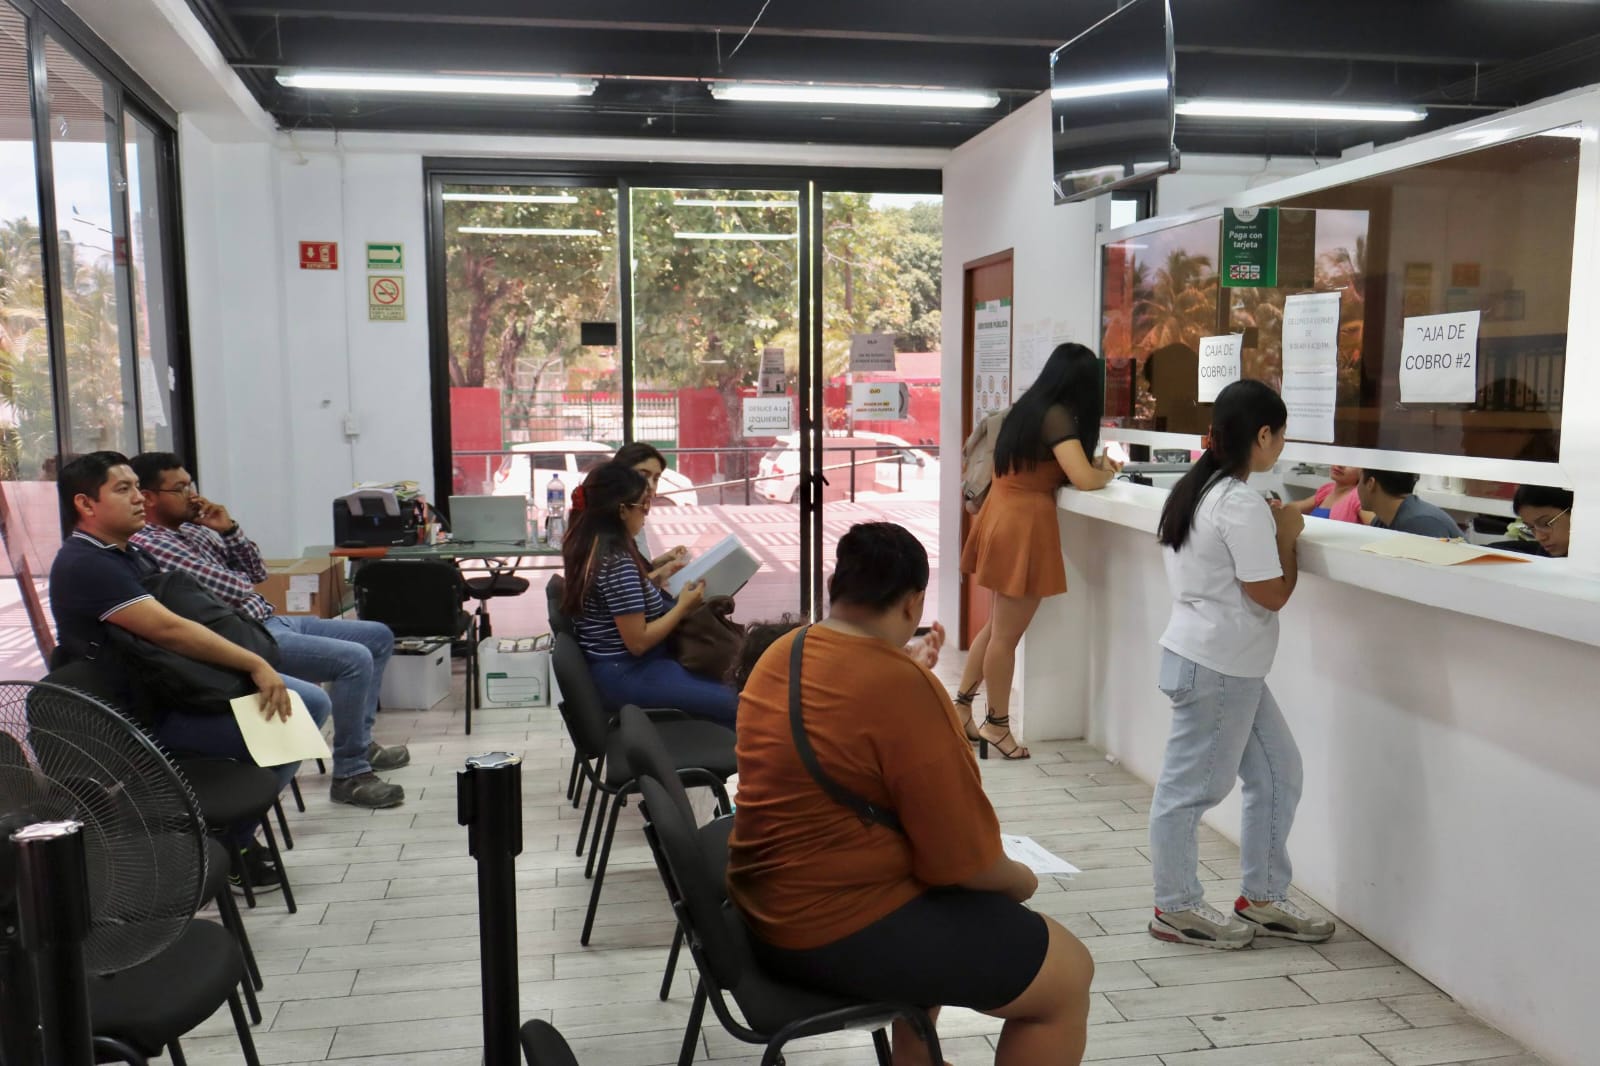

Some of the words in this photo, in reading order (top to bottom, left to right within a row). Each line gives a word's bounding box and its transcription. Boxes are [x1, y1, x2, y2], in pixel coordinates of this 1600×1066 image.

[1228, 231, 1248, 240] Paga
[1233, 240, 1258, 249] tarjeta
[1447, 323, 1467, 340] DE
[1205, 344, 1223, 357] CAJA
[1223, 343, 1234, 356] DE
[1405, 353, 1452, 370] COBRO
[1455, 352, 1471, 368] #2
[1200, 365, 1226, 378] COBRO
[1228, 365, 1237, 377] #1
[748, 415, 787, 423] IZQUIERDA
